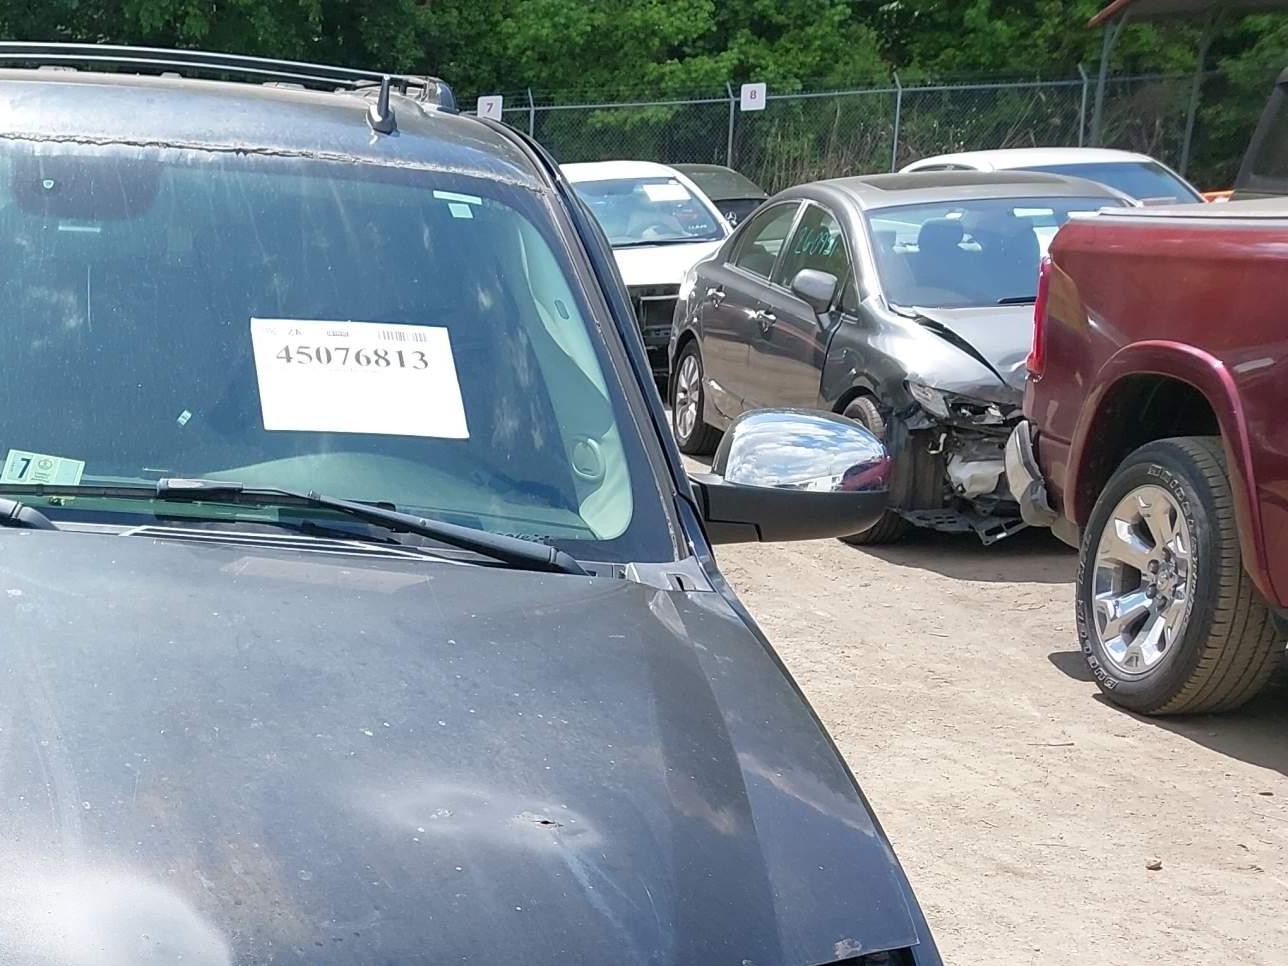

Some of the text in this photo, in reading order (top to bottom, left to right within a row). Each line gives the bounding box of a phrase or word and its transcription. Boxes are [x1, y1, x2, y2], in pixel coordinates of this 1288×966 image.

[486, 102, 494, 113] 7
[275, 344, 429, 370] 45076813
[17, 457, 32, 479] 7
